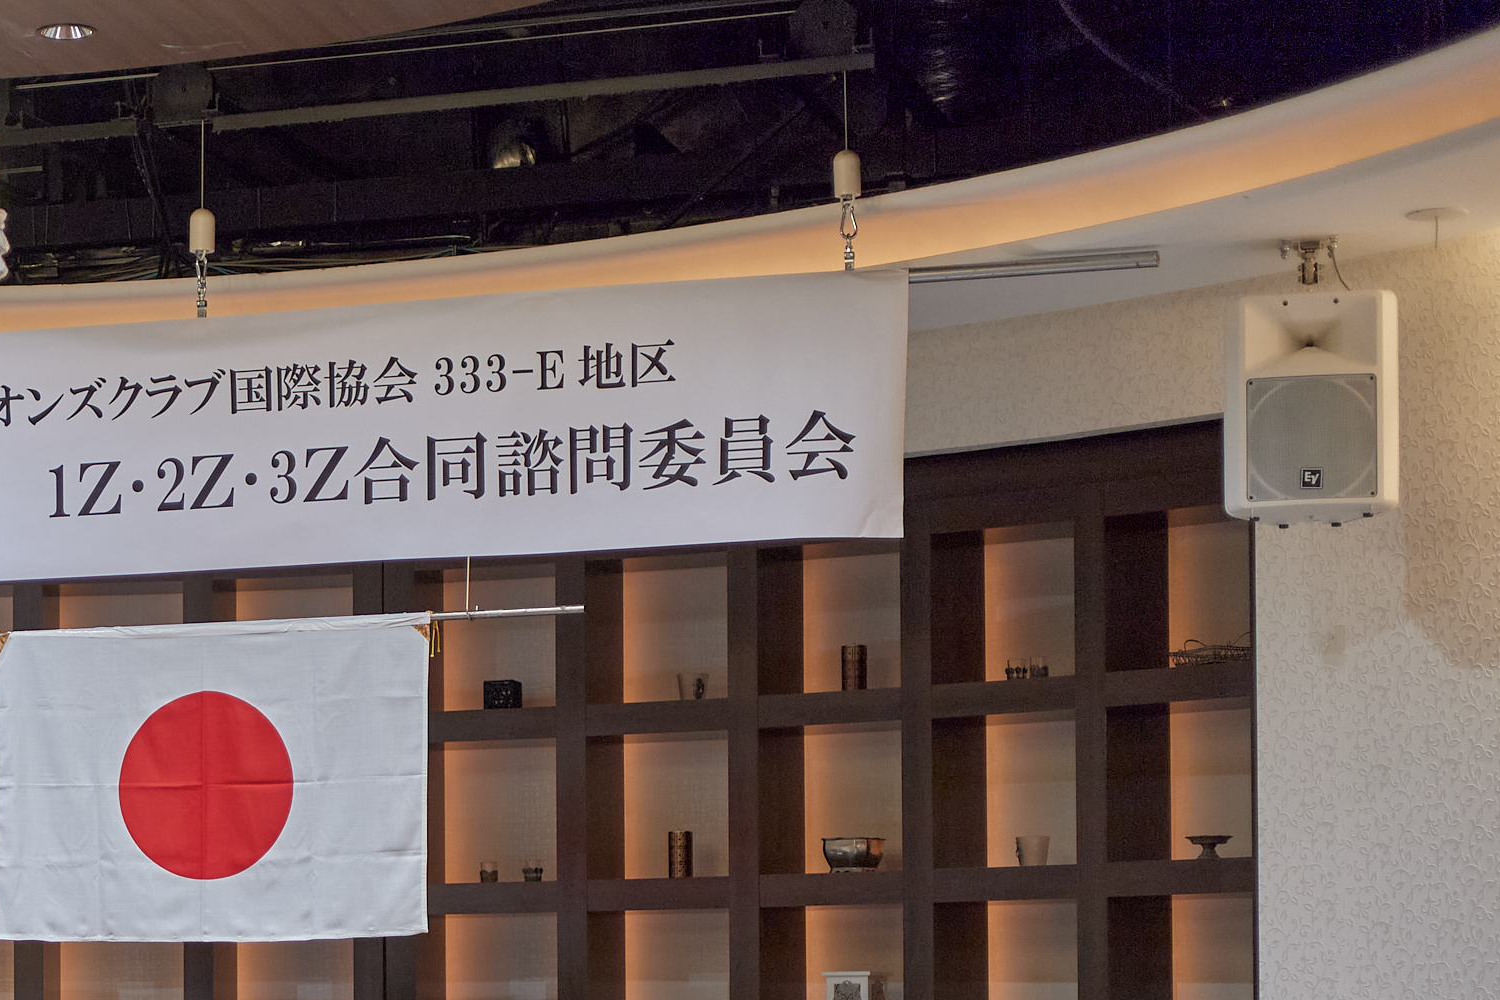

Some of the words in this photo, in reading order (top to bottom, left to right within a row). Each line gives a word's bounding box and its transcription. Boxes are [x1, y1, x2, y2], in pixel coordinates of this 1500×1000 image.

[577, 338, 677, 390] 地区
[48, 409, 856, 518] 1Z・2Z・3Z合同諮問委員会
[1304, 472, 1319, 484] EV
